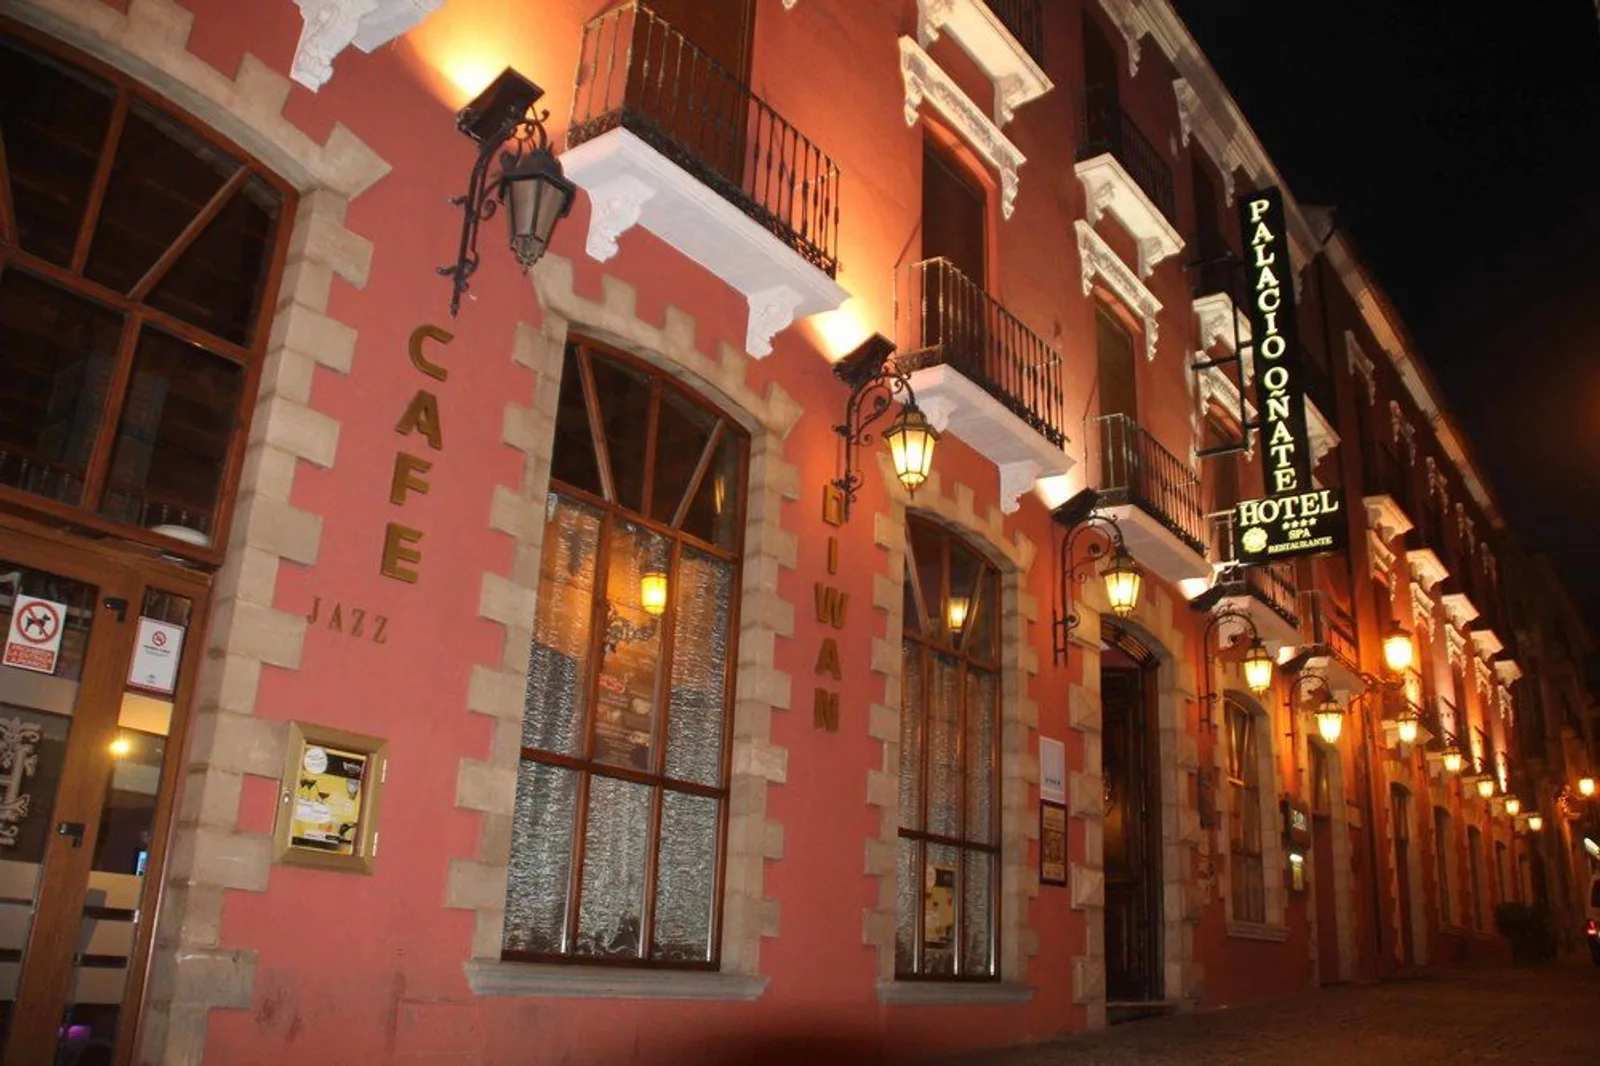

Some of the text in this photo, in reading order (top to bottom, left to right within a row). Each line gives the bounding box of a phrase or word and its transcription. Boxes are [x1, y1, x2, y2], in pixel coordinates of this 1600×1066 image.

[1249, 199, 1297, 492] PALACIO OÑATE
[380, 323, 454, 585] CAFE
[1239, 489, 1339, 527] HOTEL
[1288, 527, 1311, 540] SPA
[1267, 536, 1333, 554] RESTAURANTE
[306, 594, 388, 645] JAZZ
[813, 484, 850, 733] DIWAN
